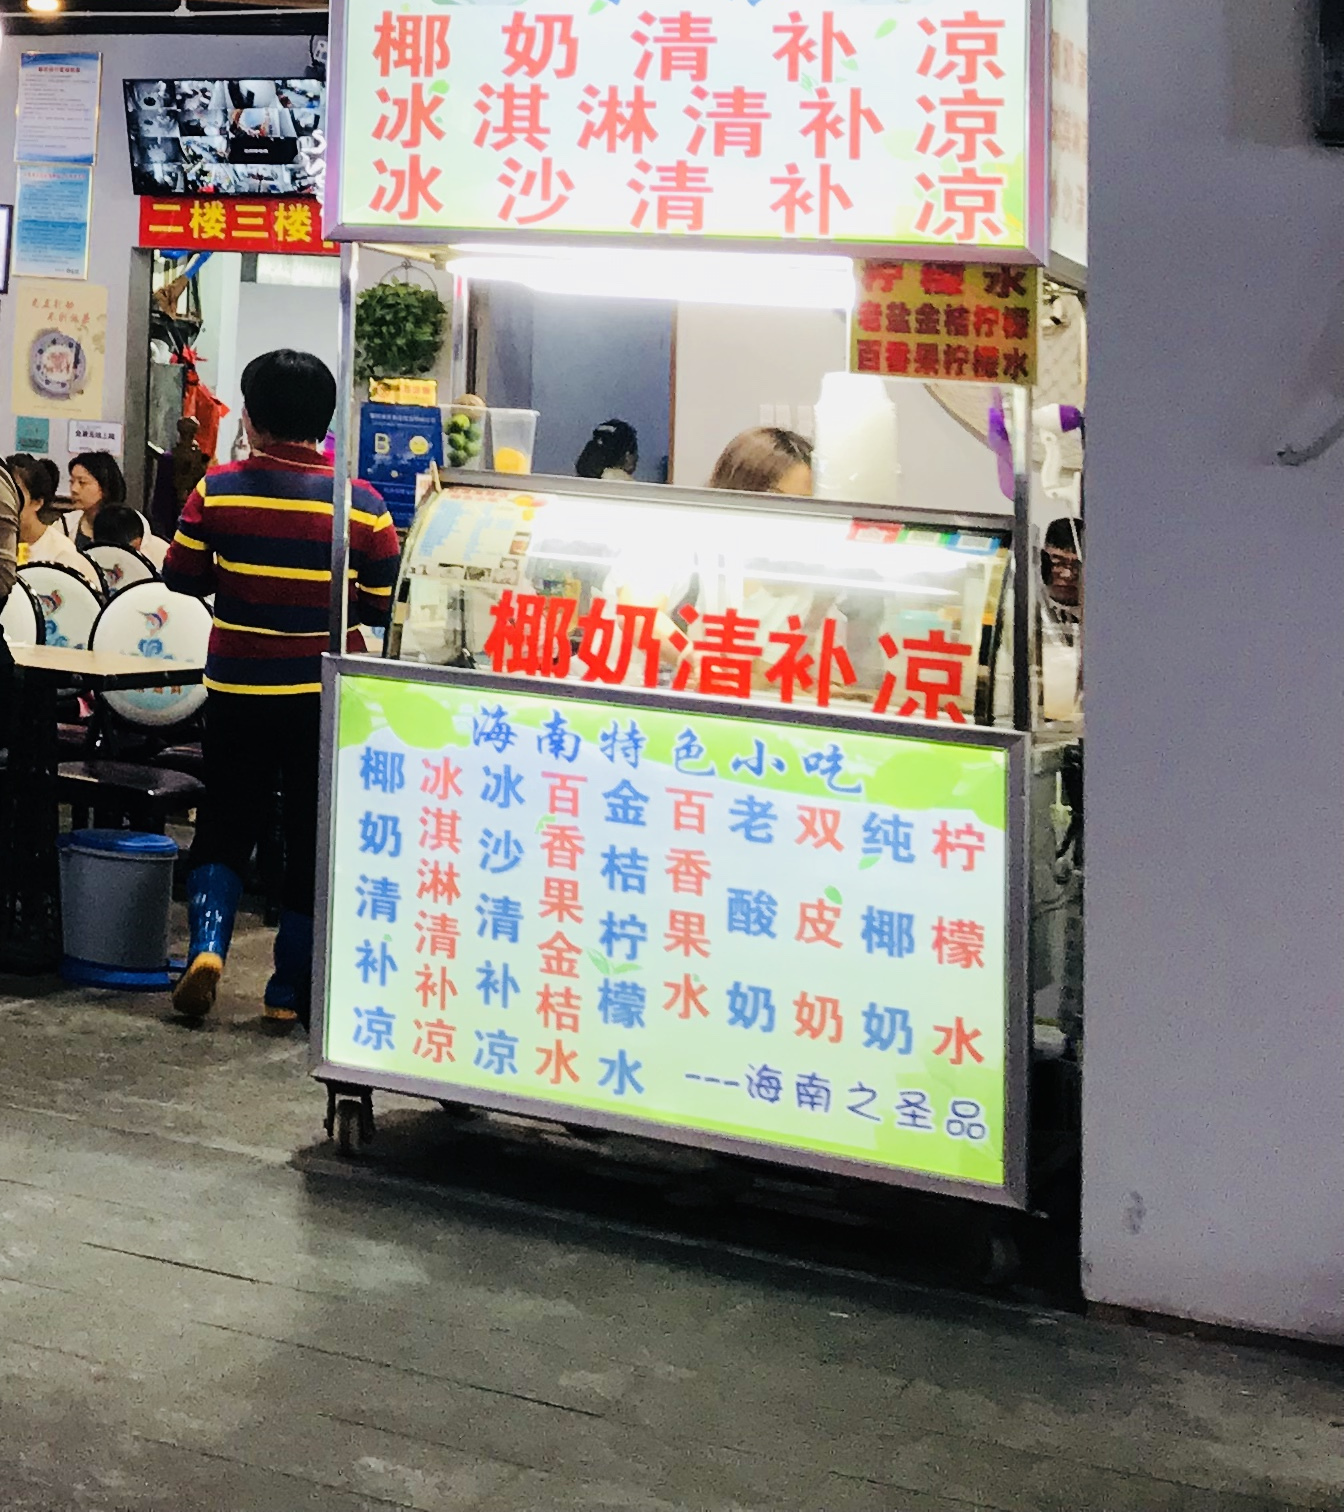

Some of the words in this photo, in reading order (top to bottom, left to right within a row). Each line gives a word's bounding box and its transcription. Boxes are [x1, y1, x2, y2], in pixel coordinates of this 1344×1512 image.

[371, 82, 1007, 163] 冰淇淋清补凉
[372, 9, 1007, 85] 椰奶清补凉
[149, 201, 334, 248] 二楼三楼
[368, 155, 1007, 242] 冰沙清补凉
[471, 705, 864, 794] 海南特色小吃
[483, 588, 978, 724] 椰奶清补凉
[352, 746, 406, 1053] 椰奶清补凉
[412, 756, 463, 1064] 冰淇淋清补凉
[474, 764, 526, 1076] 冰沙清补凉
[535, 771, 588, 1086] 百香果金桔水
[598, 779, 650, 1097] 金桔柠檬水
[662, 787, 714, 1021] 百香果水
[725, 795, 778, 1035] 老酸奶
[793, 804, 844, 1045] 双皮奶
[860, 811, 916, 1057] 纯椰奶
[930, 819, 986, 1066] 柠檬水
